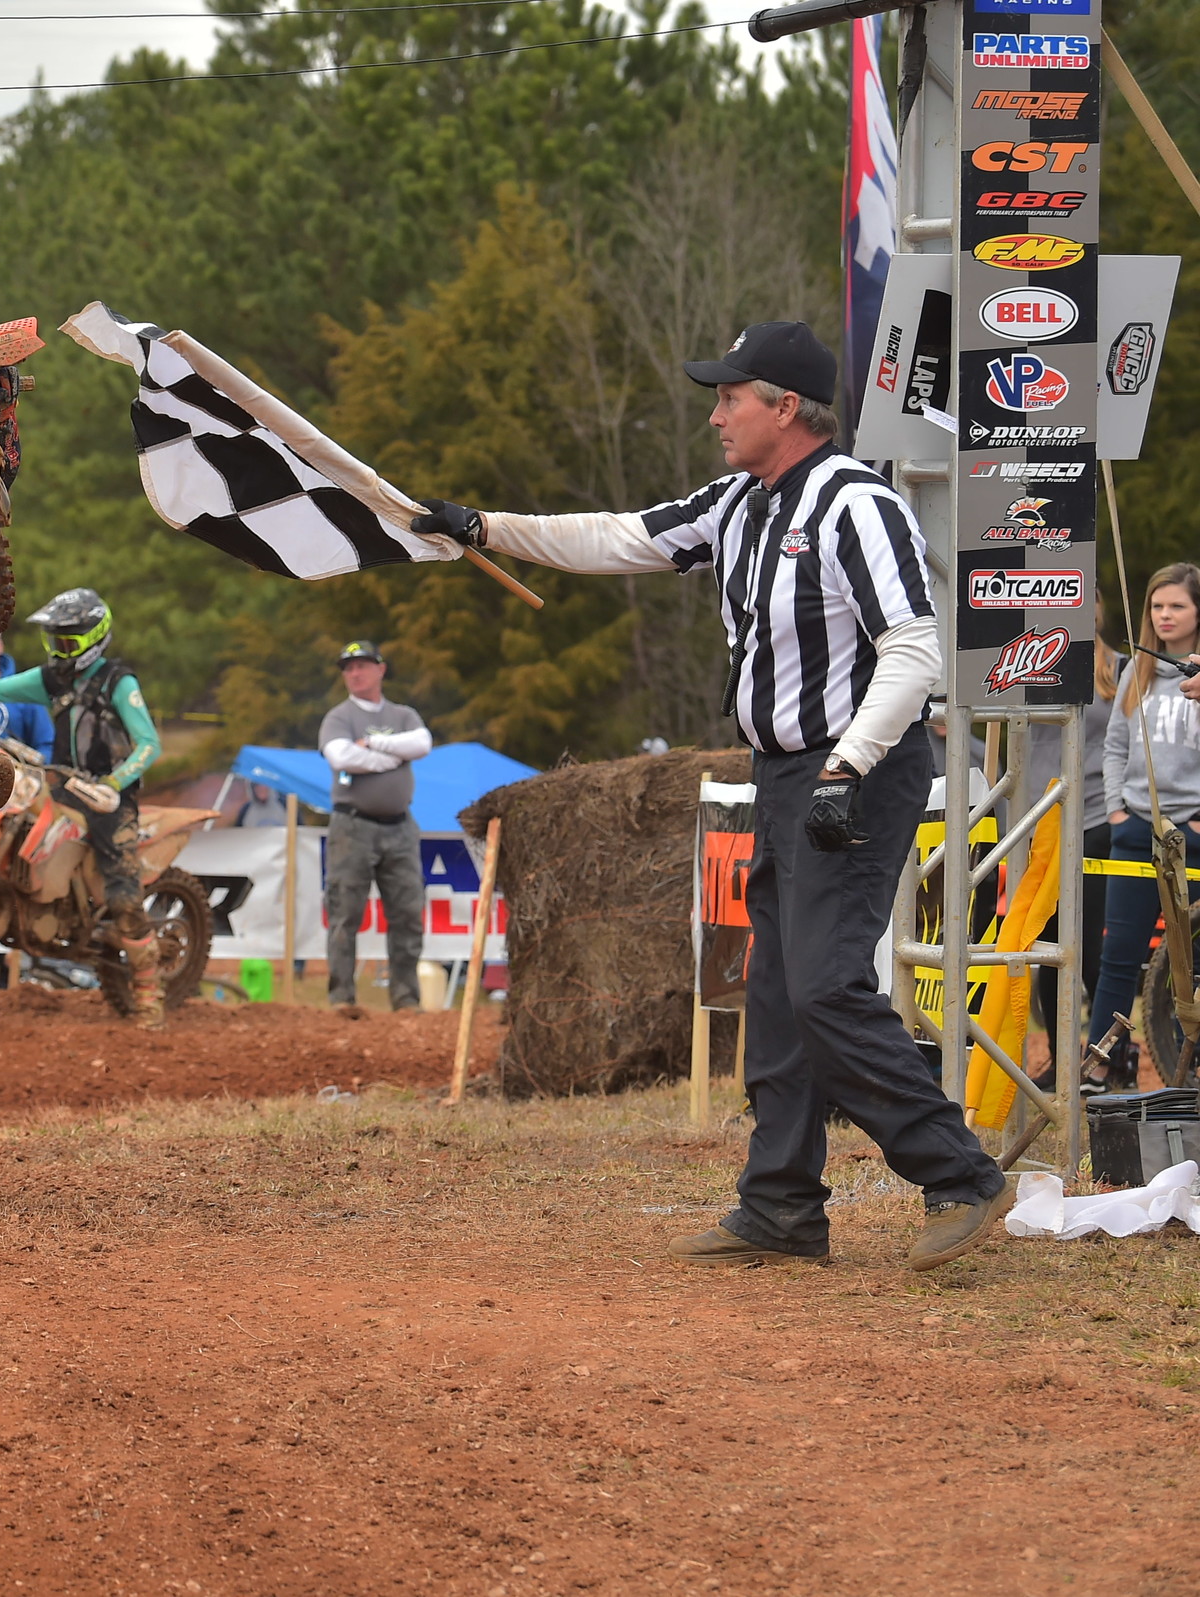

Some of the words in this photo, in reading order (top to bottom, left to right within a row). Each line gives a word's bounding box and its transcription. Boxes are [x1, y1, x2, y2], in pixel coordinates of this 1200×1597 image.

[974, 34, 1089, 55] PARTS
[974, 54, 1089, 68] UNLIMITED
[972, 90, 1089, 110] MOOSE
[1016, 109, 1078, 120] RACING
[971, 141, 1089, 173] CST
[976, 192, 1086, 209] GBC
[975, 239, 1084, 261] FMF
[997, 302, 1062, 323] BELL
[1120, 327, 1147, 390] GNCC
[907, 354, 940, 410] LAPS
[990, 356, 1045, 408] VP
[1026, 383, 1070, 400] Racing
[988, 438, 1046, 447] MOTORCYCLE
[1050, 438, 1078, 446] TIRES
[991, 426, 1086, 439] DUNLOP
[982, 528, 1016, 540] ALL
[1016, 528, 1071, 540] BALLS
[1037, 539, 1072, 552] Racing
[973, 570, 1080, 598] HOTCAMS
